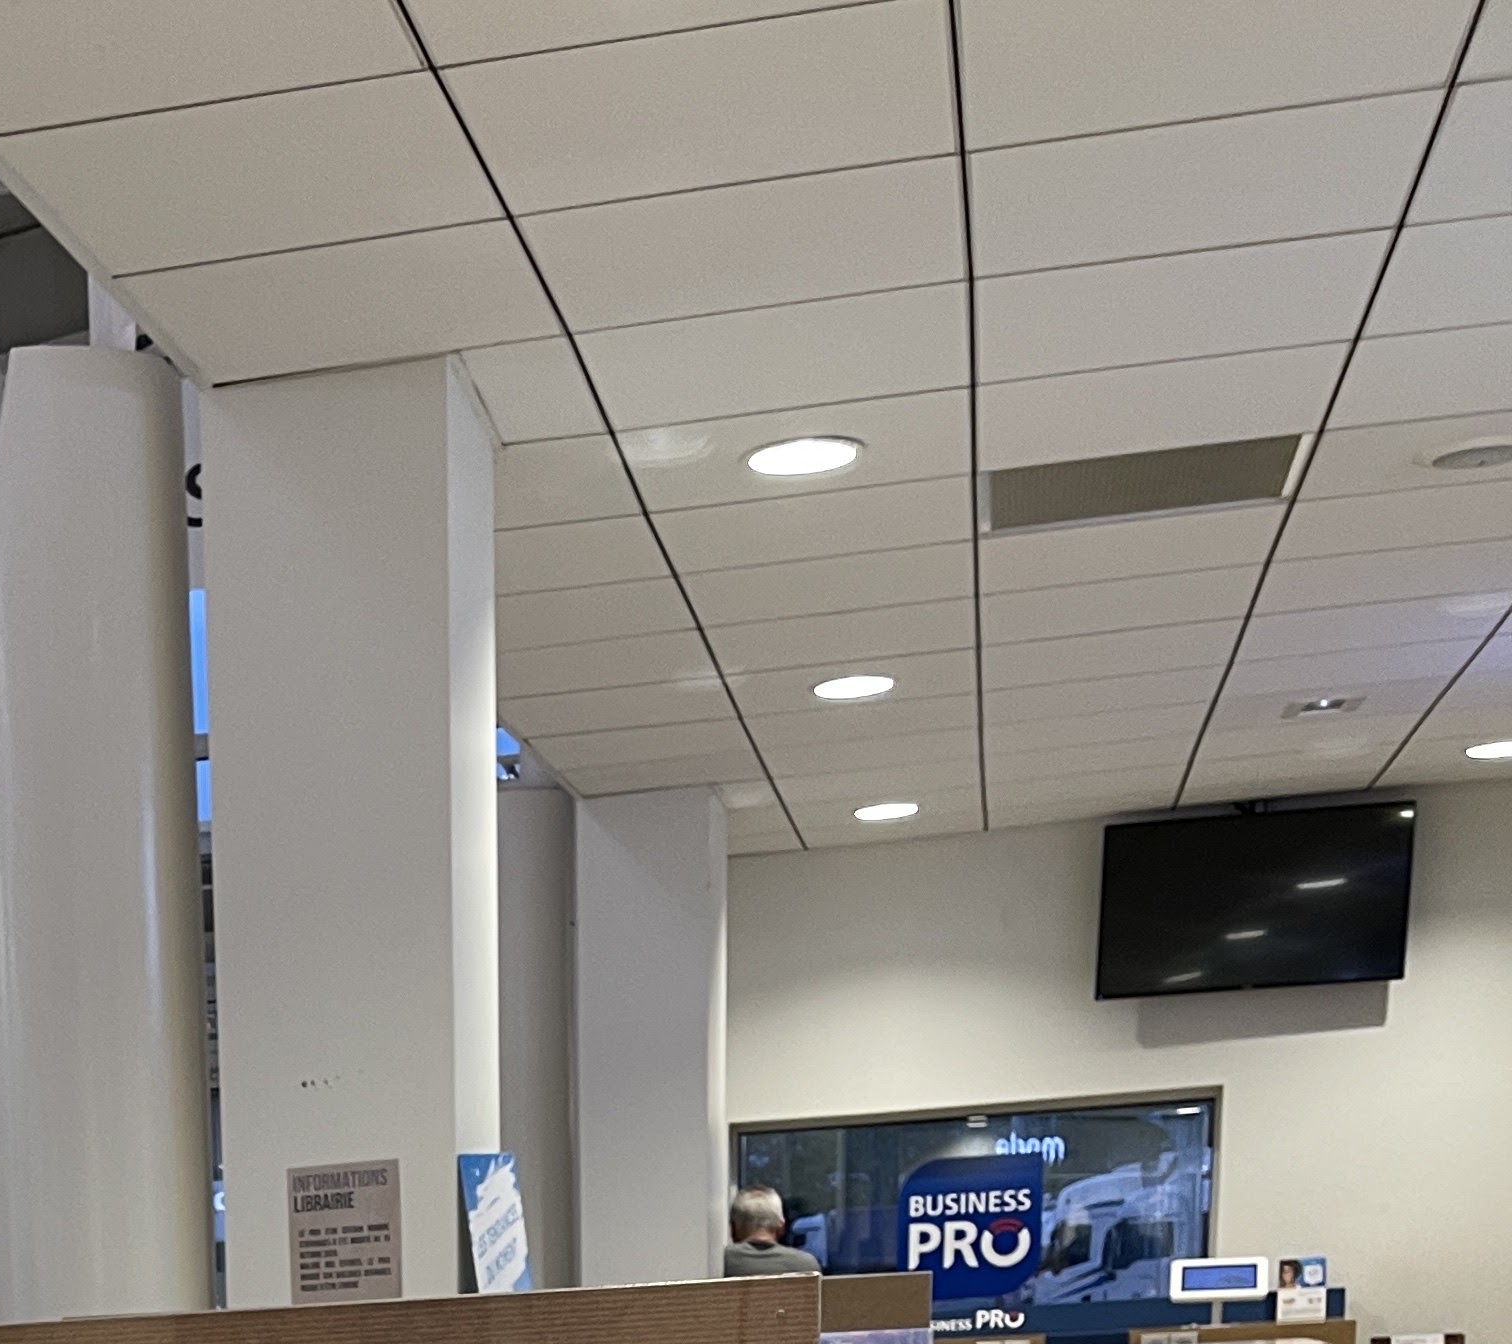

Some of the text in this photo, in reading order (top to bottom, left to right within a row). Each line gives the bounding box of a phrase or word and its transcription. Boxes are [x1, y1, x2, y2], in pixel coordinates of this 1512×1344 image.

[292, 1169, 388, 1192] INFORMATIONS
[293, 1191, 354, 1213] LIBRAIRIE
[909, 1189, 1031, 1217] BUSINESS
[908, 1218, 1031, 1270] PRO
[976, 1309, 1024, 1328] PRO
